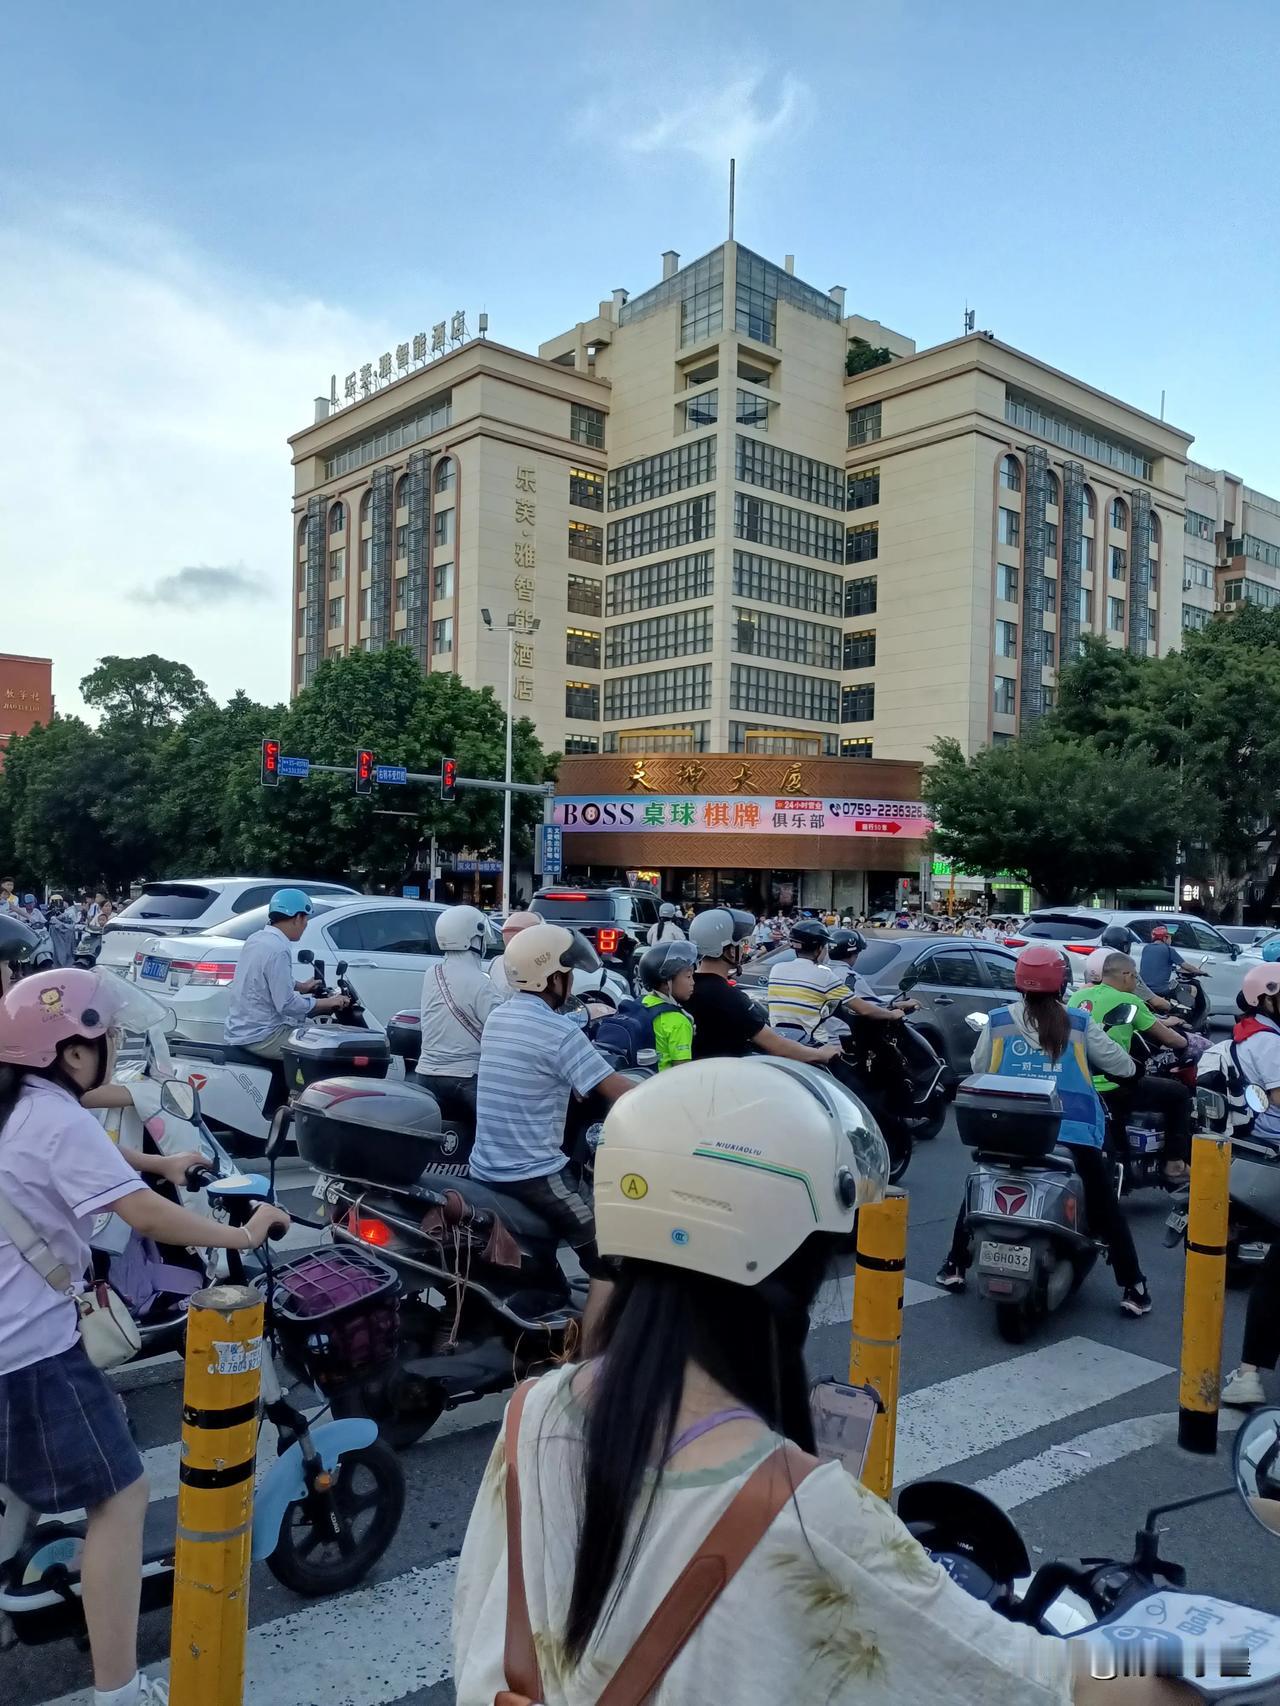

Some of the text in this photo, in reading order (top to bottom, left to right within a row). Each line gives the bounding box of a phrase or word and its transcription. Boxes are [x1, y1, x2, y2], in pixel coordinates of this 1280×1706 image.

[641, 802, 762, 828] 桌球 棋牌
[771, 812, 825, 829] 俱乐部
[627, 1178, 639, 1195] A
[993, 1252, 1028, 1267] GH032
